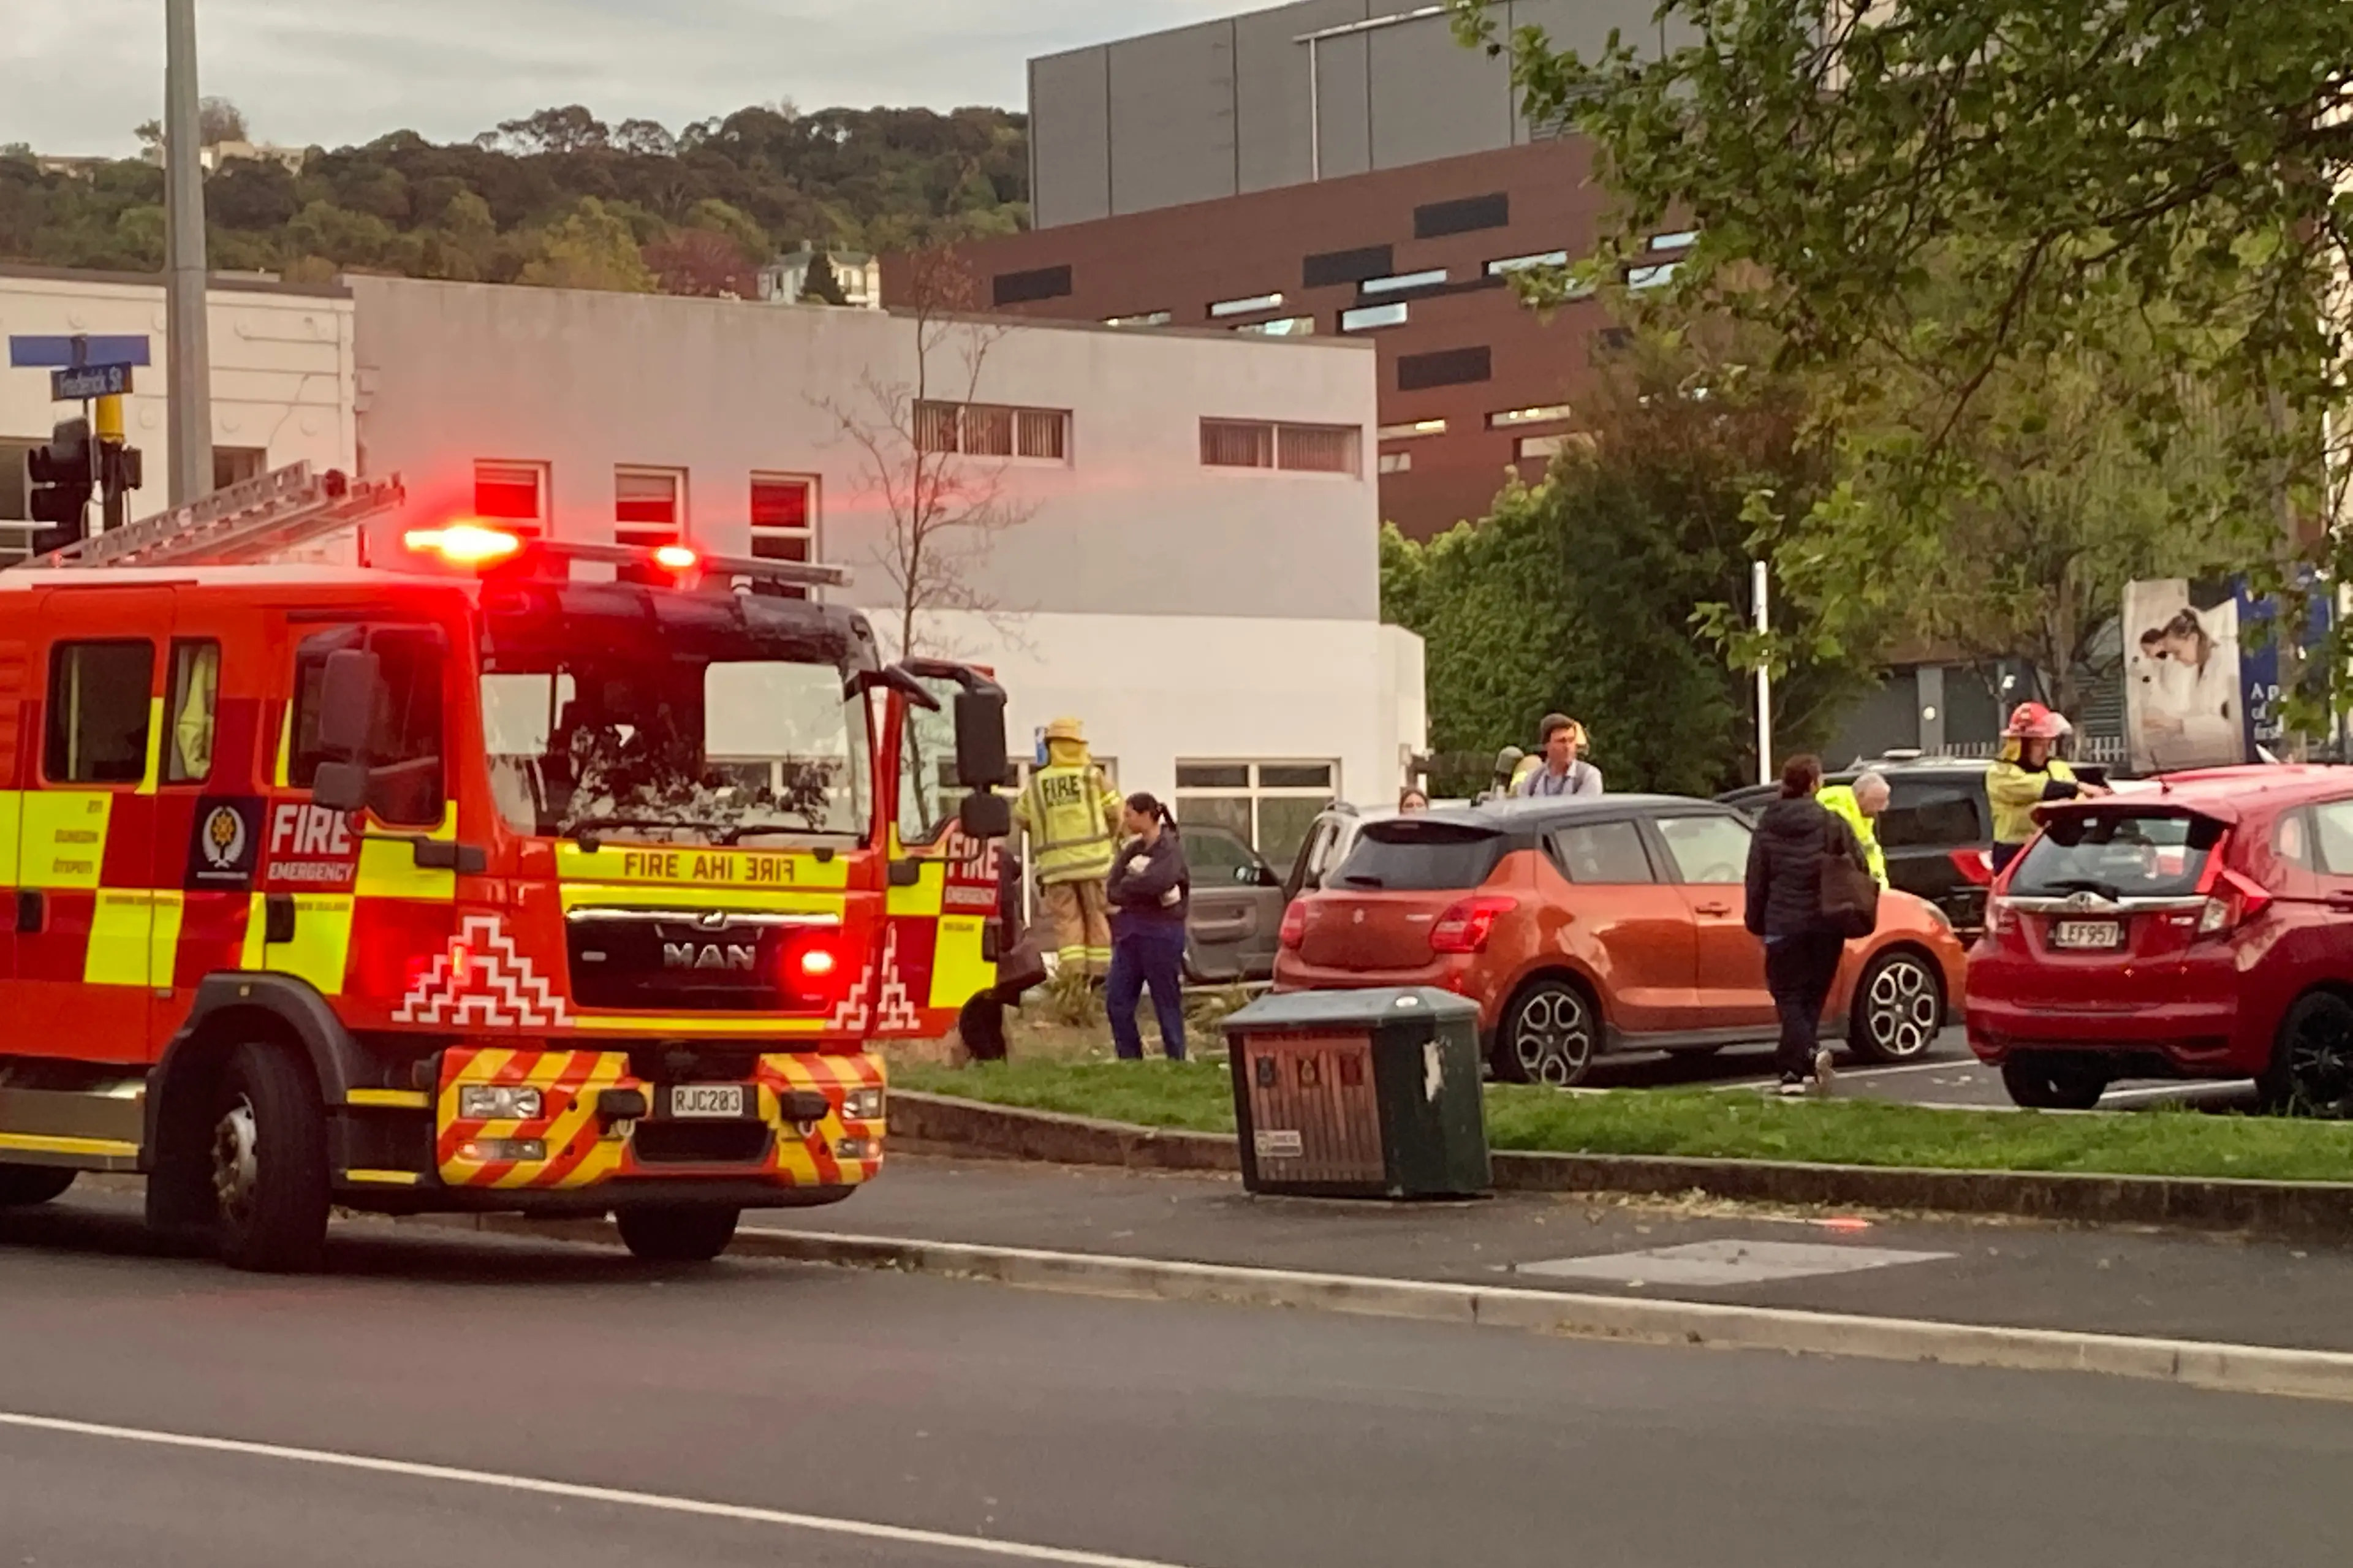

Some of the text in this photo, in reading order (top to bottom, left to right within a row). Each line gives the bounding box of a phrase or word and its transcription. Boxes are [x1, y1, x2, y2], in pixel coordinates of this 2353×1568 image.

[2251, 682, 2265, 700] A
[1042, 775, 1080, 803] FIRE
[270, 804, 351, 854] FIRE
[624, 852, 680, 878] FIRE
[692, 855, 733, 881] AHI
[947, 832, 1004, 880] FIRE
[268, 862, 355, 882] EMERGENCY
[2058, 924, 2116, 944] LEF957
[663, 942, 756, 971] MAN
[675, 1091, 740, 1112] RJC203
